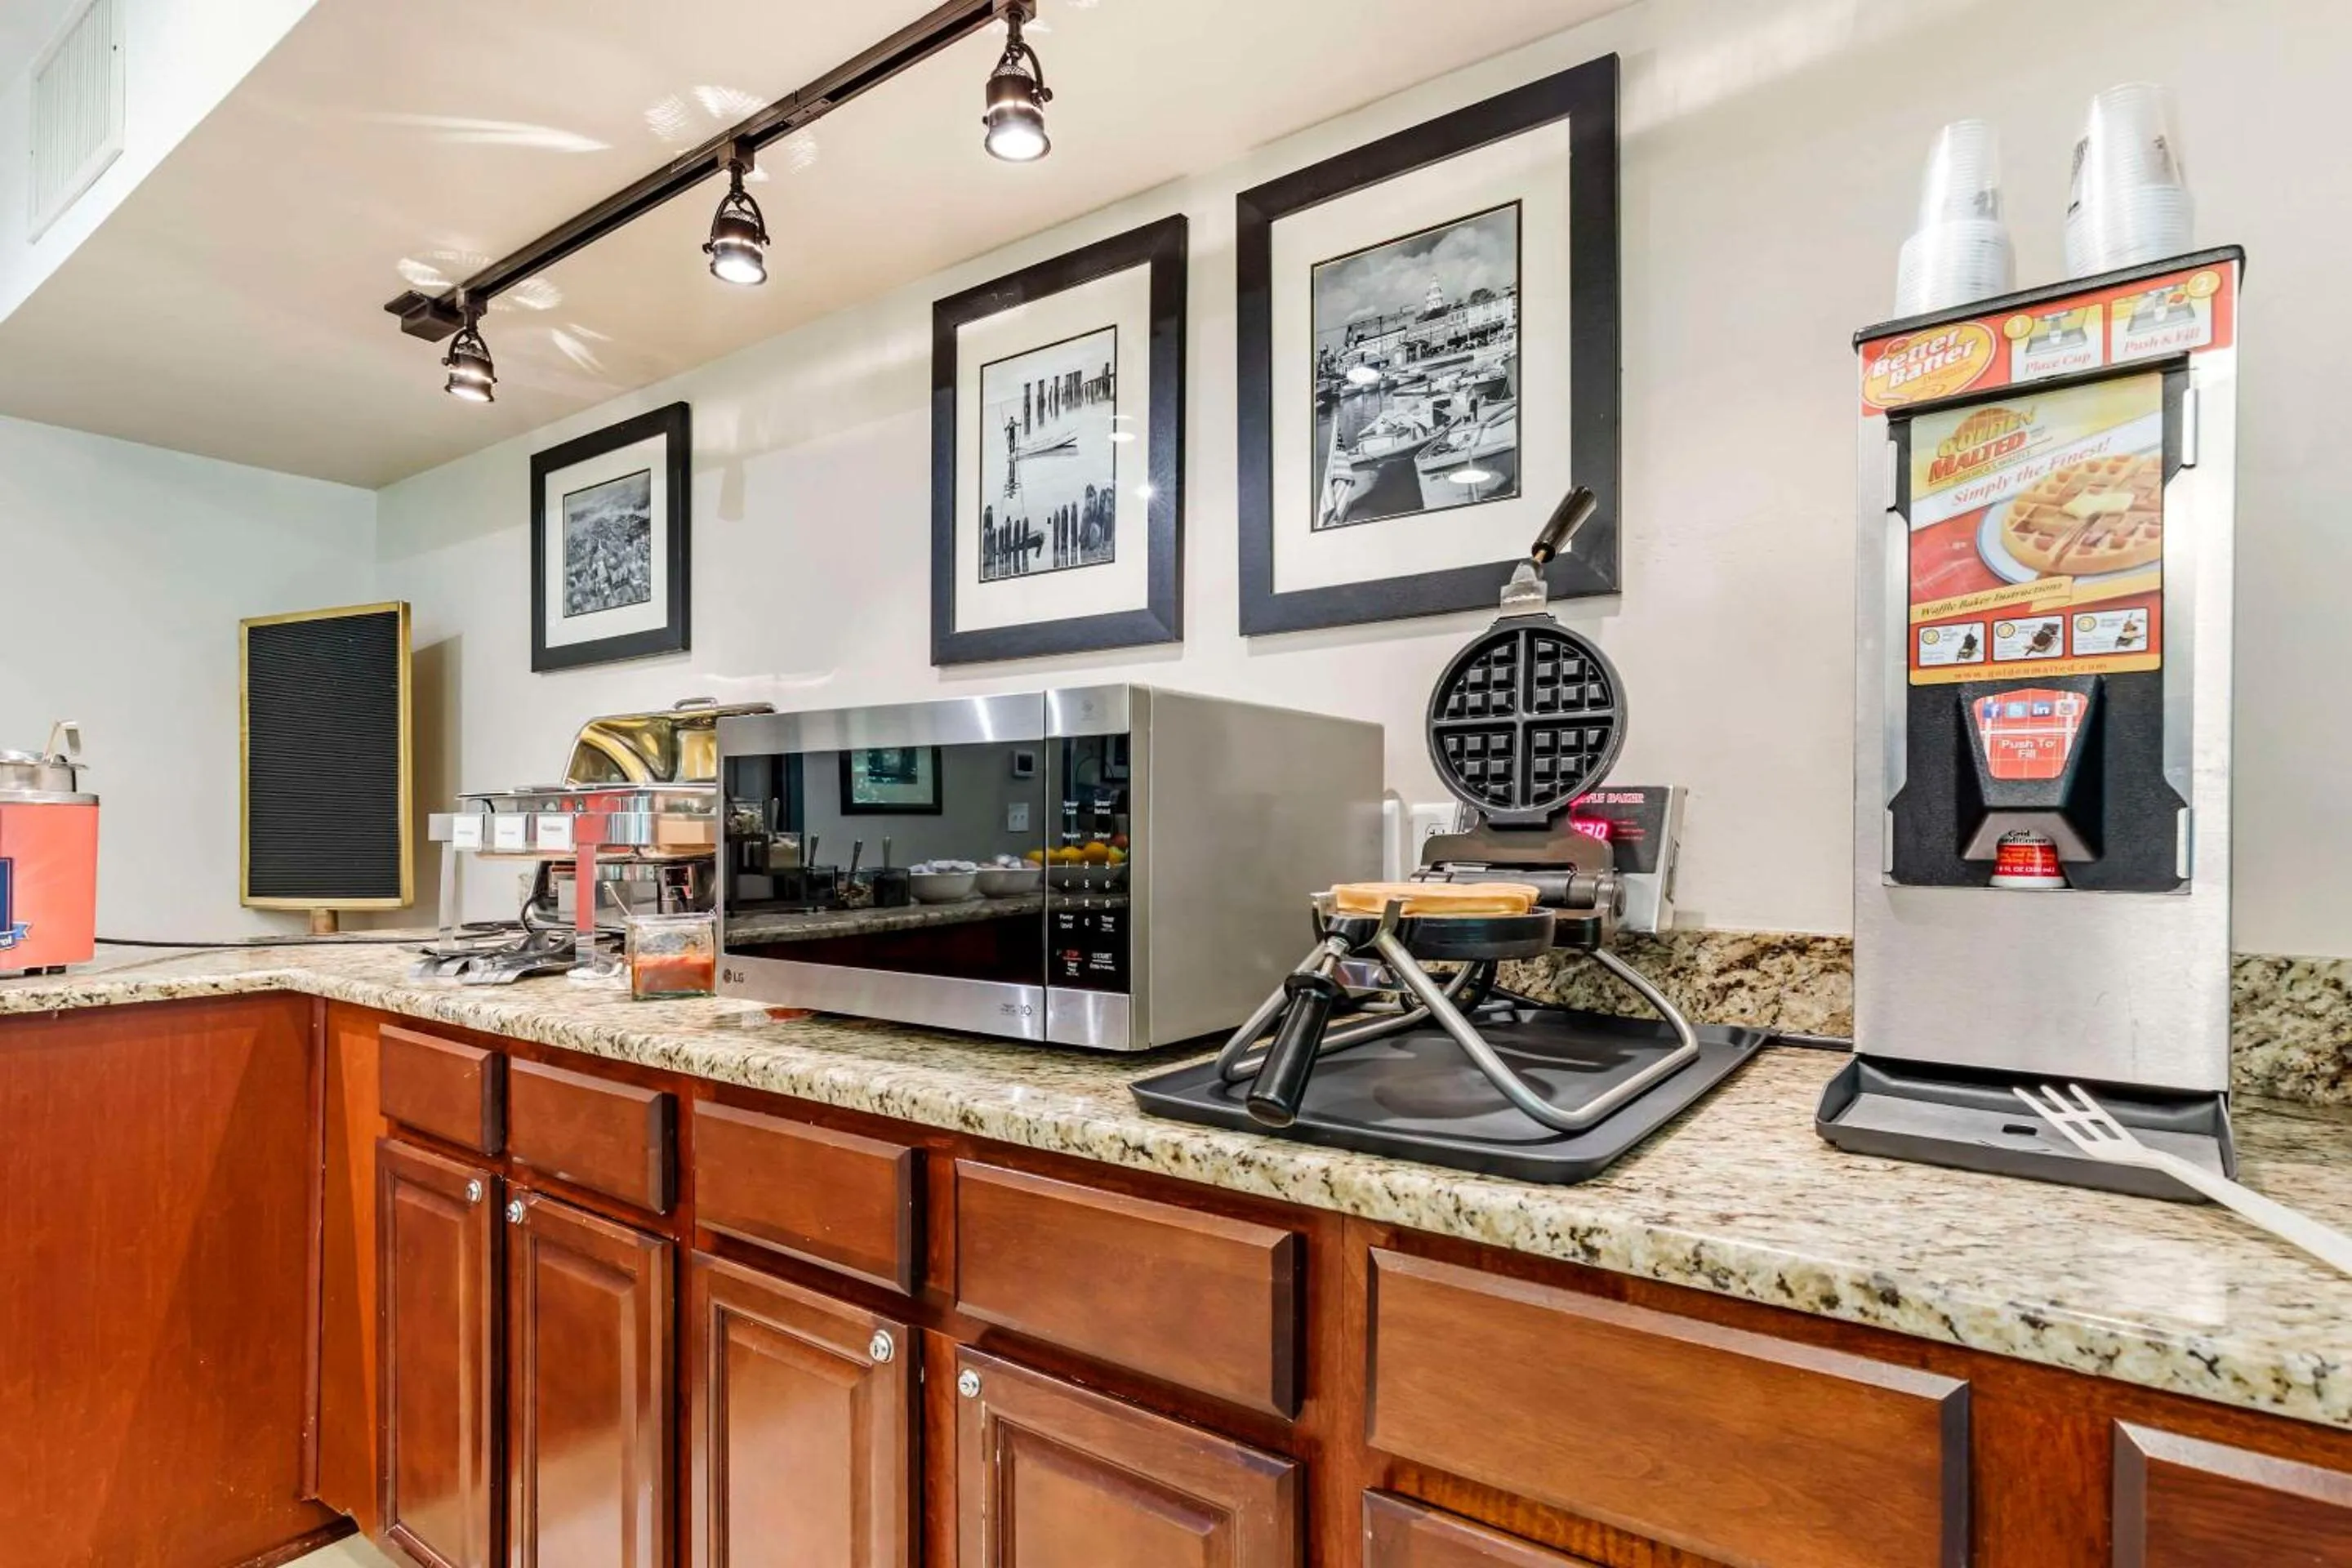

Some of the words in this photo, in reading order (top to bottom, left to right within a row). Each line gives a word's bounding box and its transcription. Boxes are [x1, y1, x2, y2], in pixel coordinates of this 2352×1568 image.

[2125, 337, 2158, 352] Push
[2175, 327, 2200, 341] Fill
[1871, 328, 1960, 380] Better
[1888, 338, 1977, 389] Batter
[2025, 360, 2059, 374] Place
[2062, 353, 2091, 366] Cup
[1928, 430, 2027, 487] MALTED
[1953, 474, 2011, 506] Simply
[2016, 466, 2043, 483] the
[2048, 437, 2111, 470] Finest!
[1993, 582, 2064, 601] Instructions
[2002, 738, 2034, 749] Push
[2038, 738, 2055, 749] To
[2018, 749, 2037, 759] Fill
[1084, 860, 1089, 870] 2
[733, 972, 745, 983] LG
